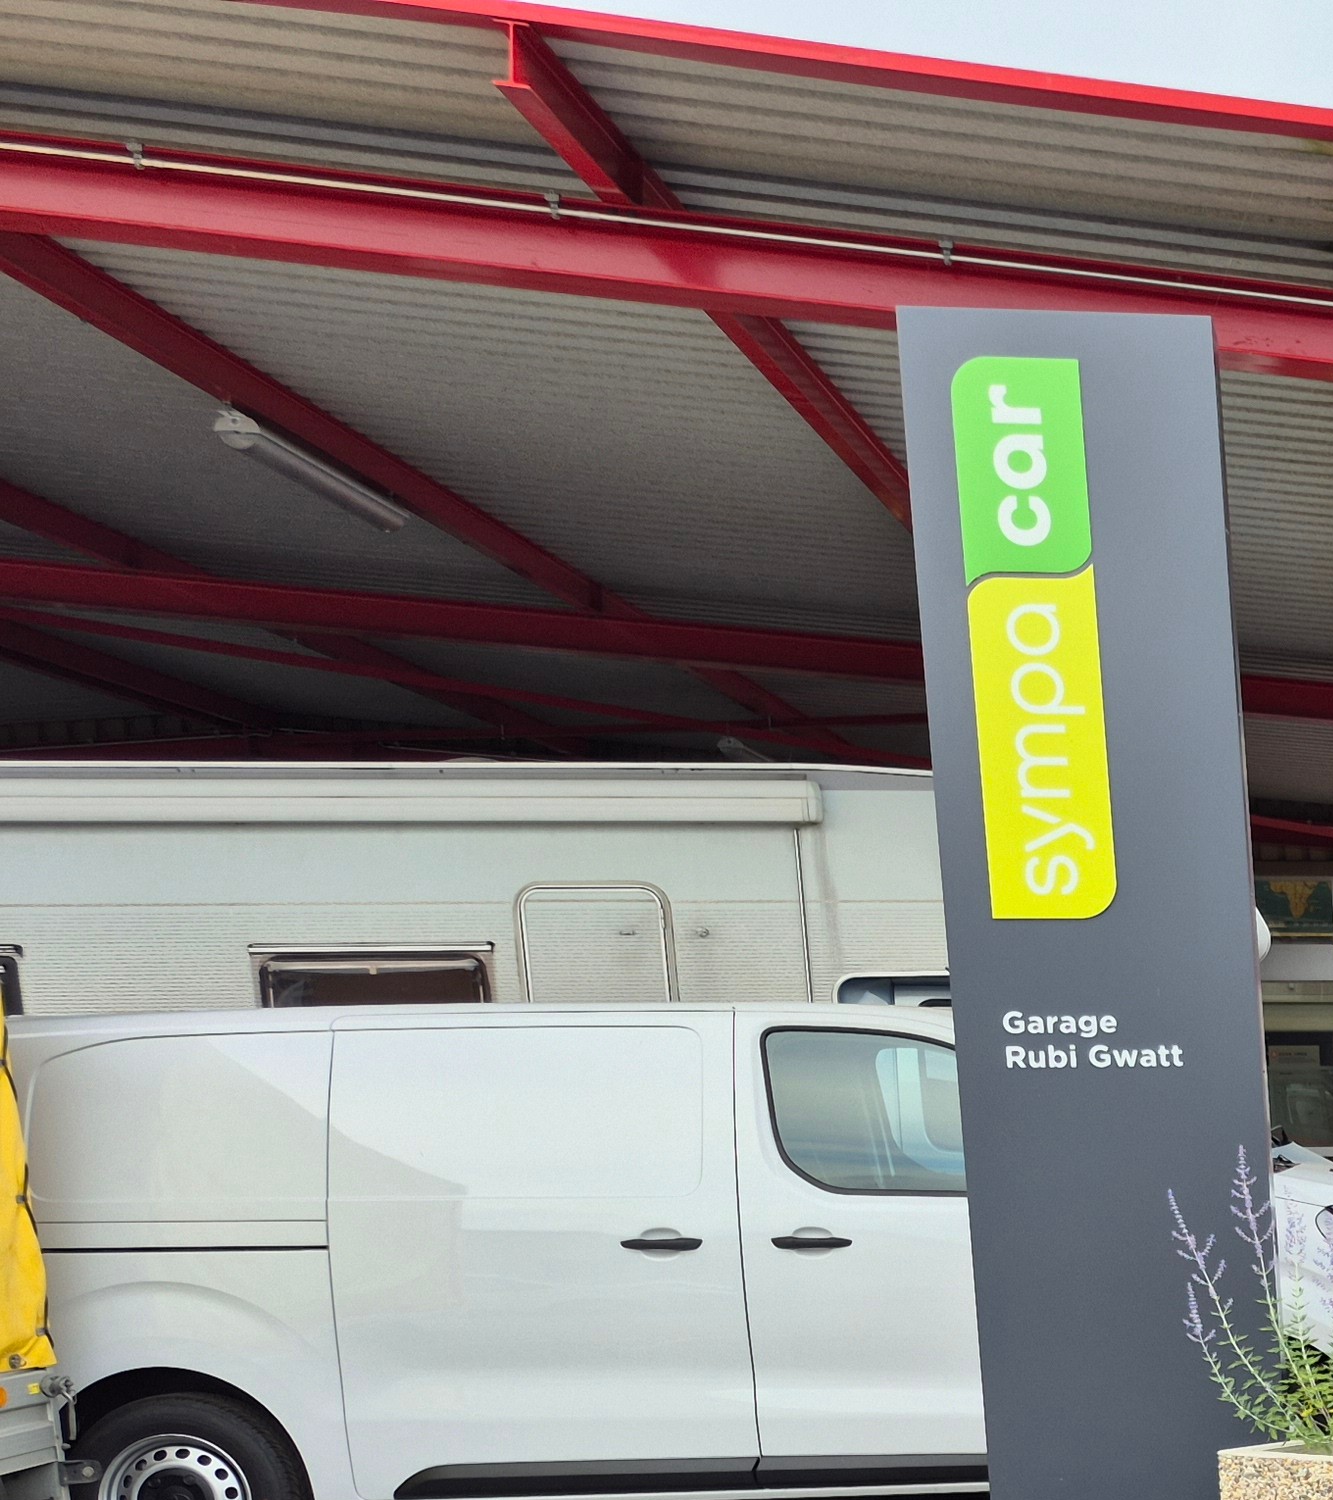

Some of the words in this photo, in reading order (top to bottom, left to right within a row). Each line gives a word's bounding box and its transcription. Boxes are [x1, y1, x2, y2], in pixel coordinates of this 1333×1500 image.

[988, 384, 1052, 547] car
[1006, 602, 1095, 896] sympa
[1002, 1010, 1118, 1038] Garage
[1005, 1044, 1077, 1068] Rubi
[1088, 1044, 1184, 1068] Gwatt
